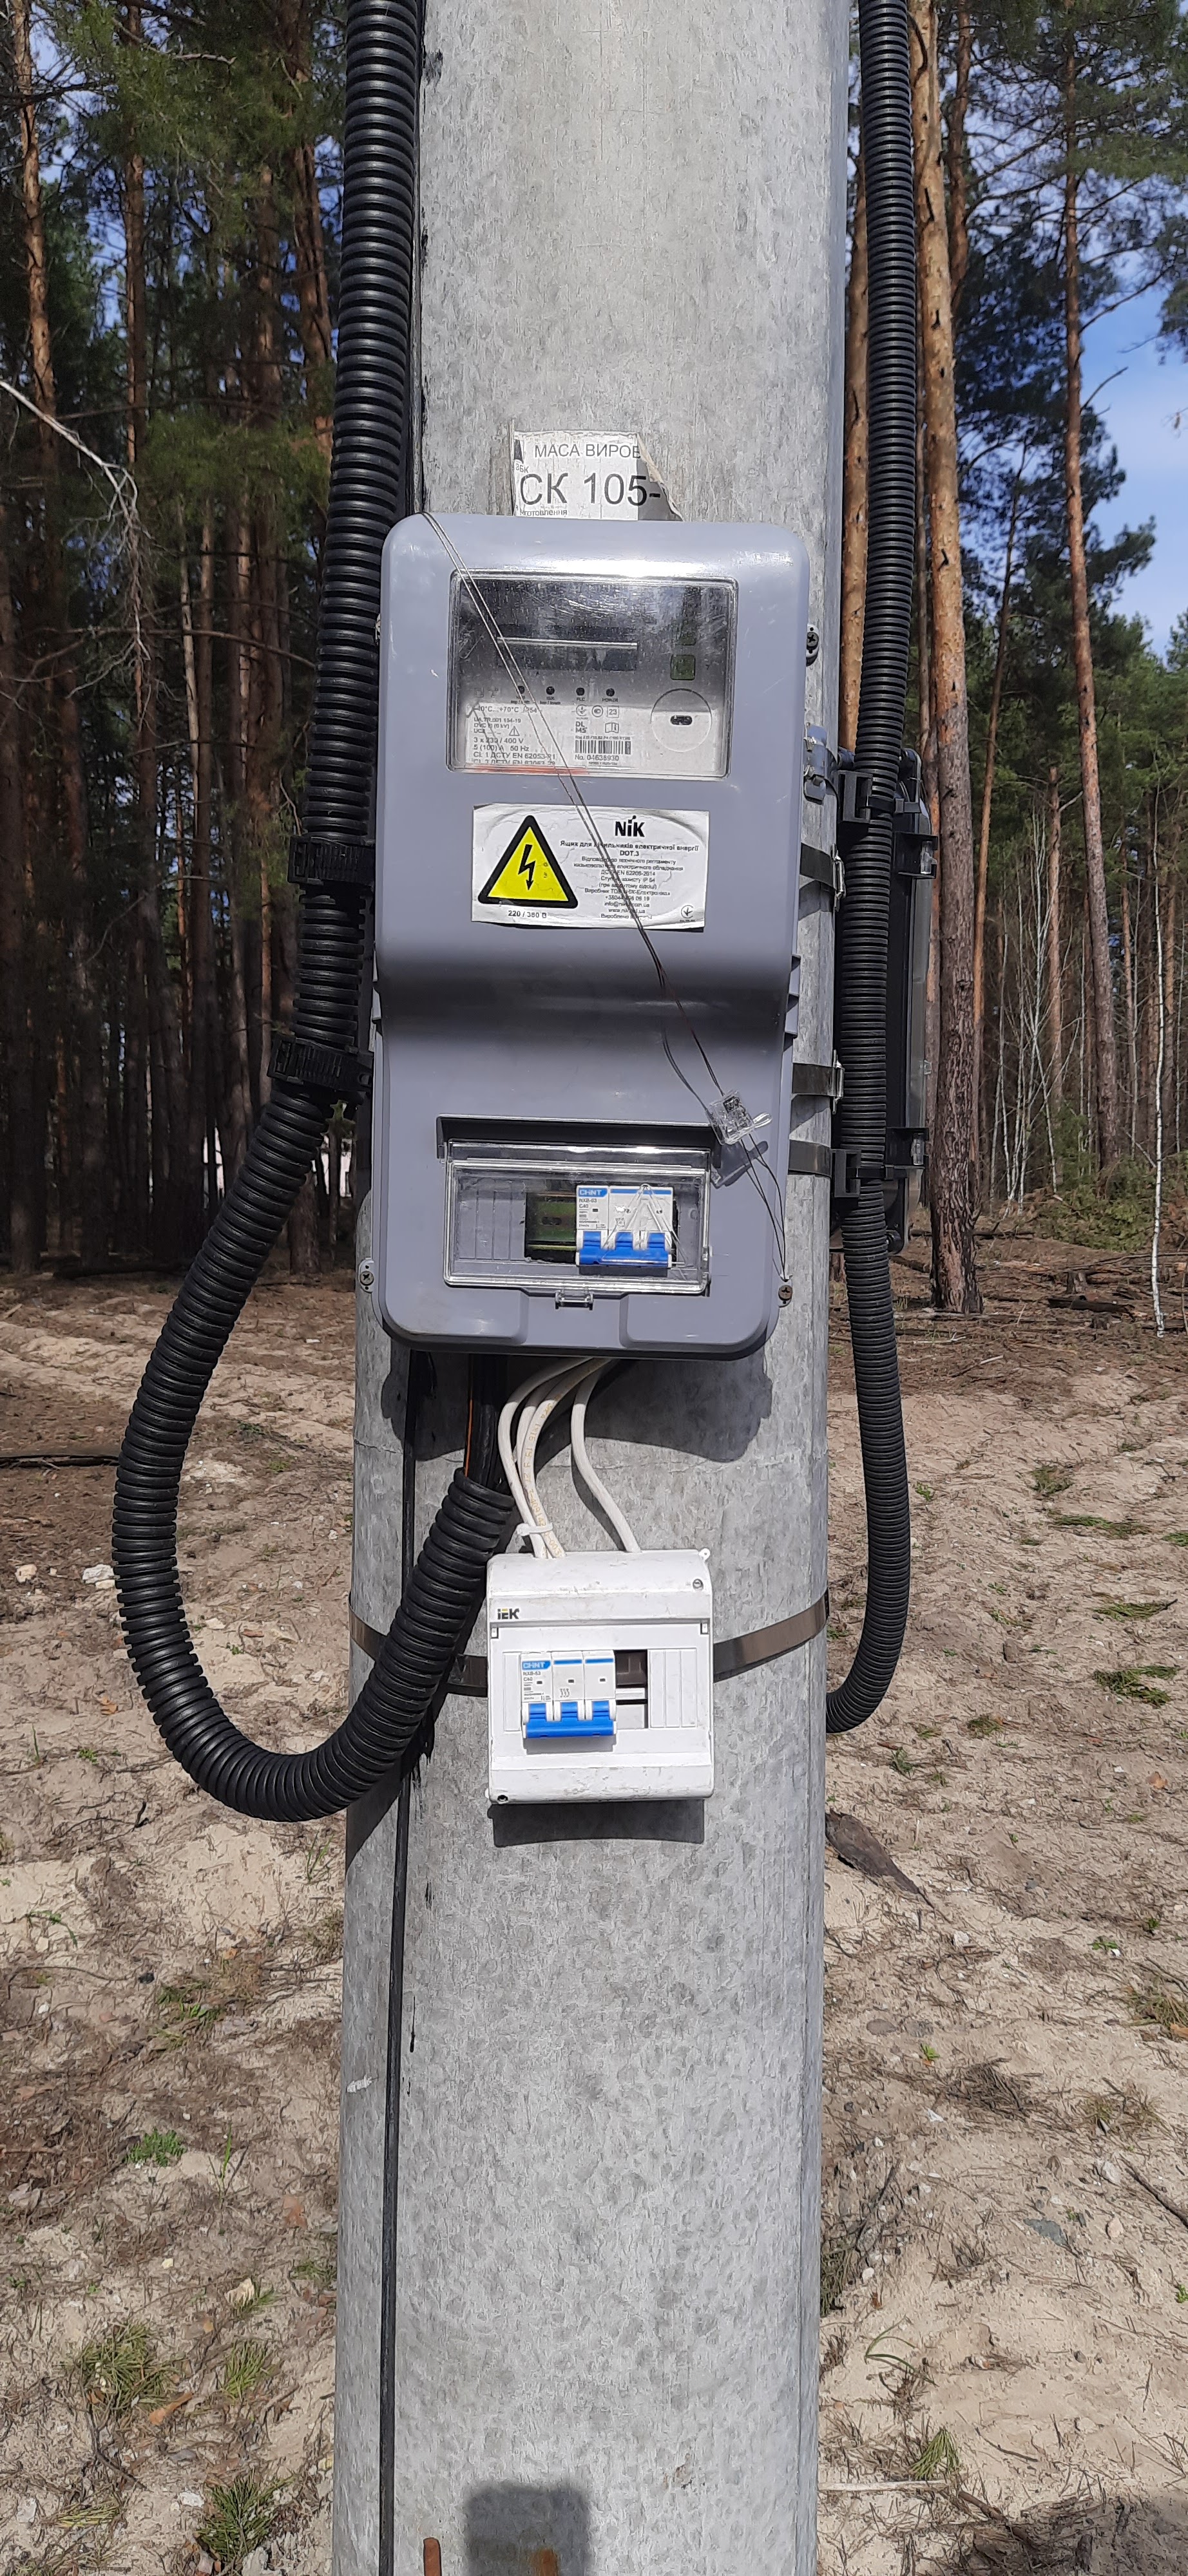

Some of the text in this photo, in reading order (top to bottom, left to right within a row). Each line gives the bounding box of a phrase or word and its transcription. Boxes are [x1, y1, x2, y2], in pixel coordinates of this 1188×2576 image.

[535, 444, 580, 458] МАСА
[520, 473, 661, 506] СК 105-
